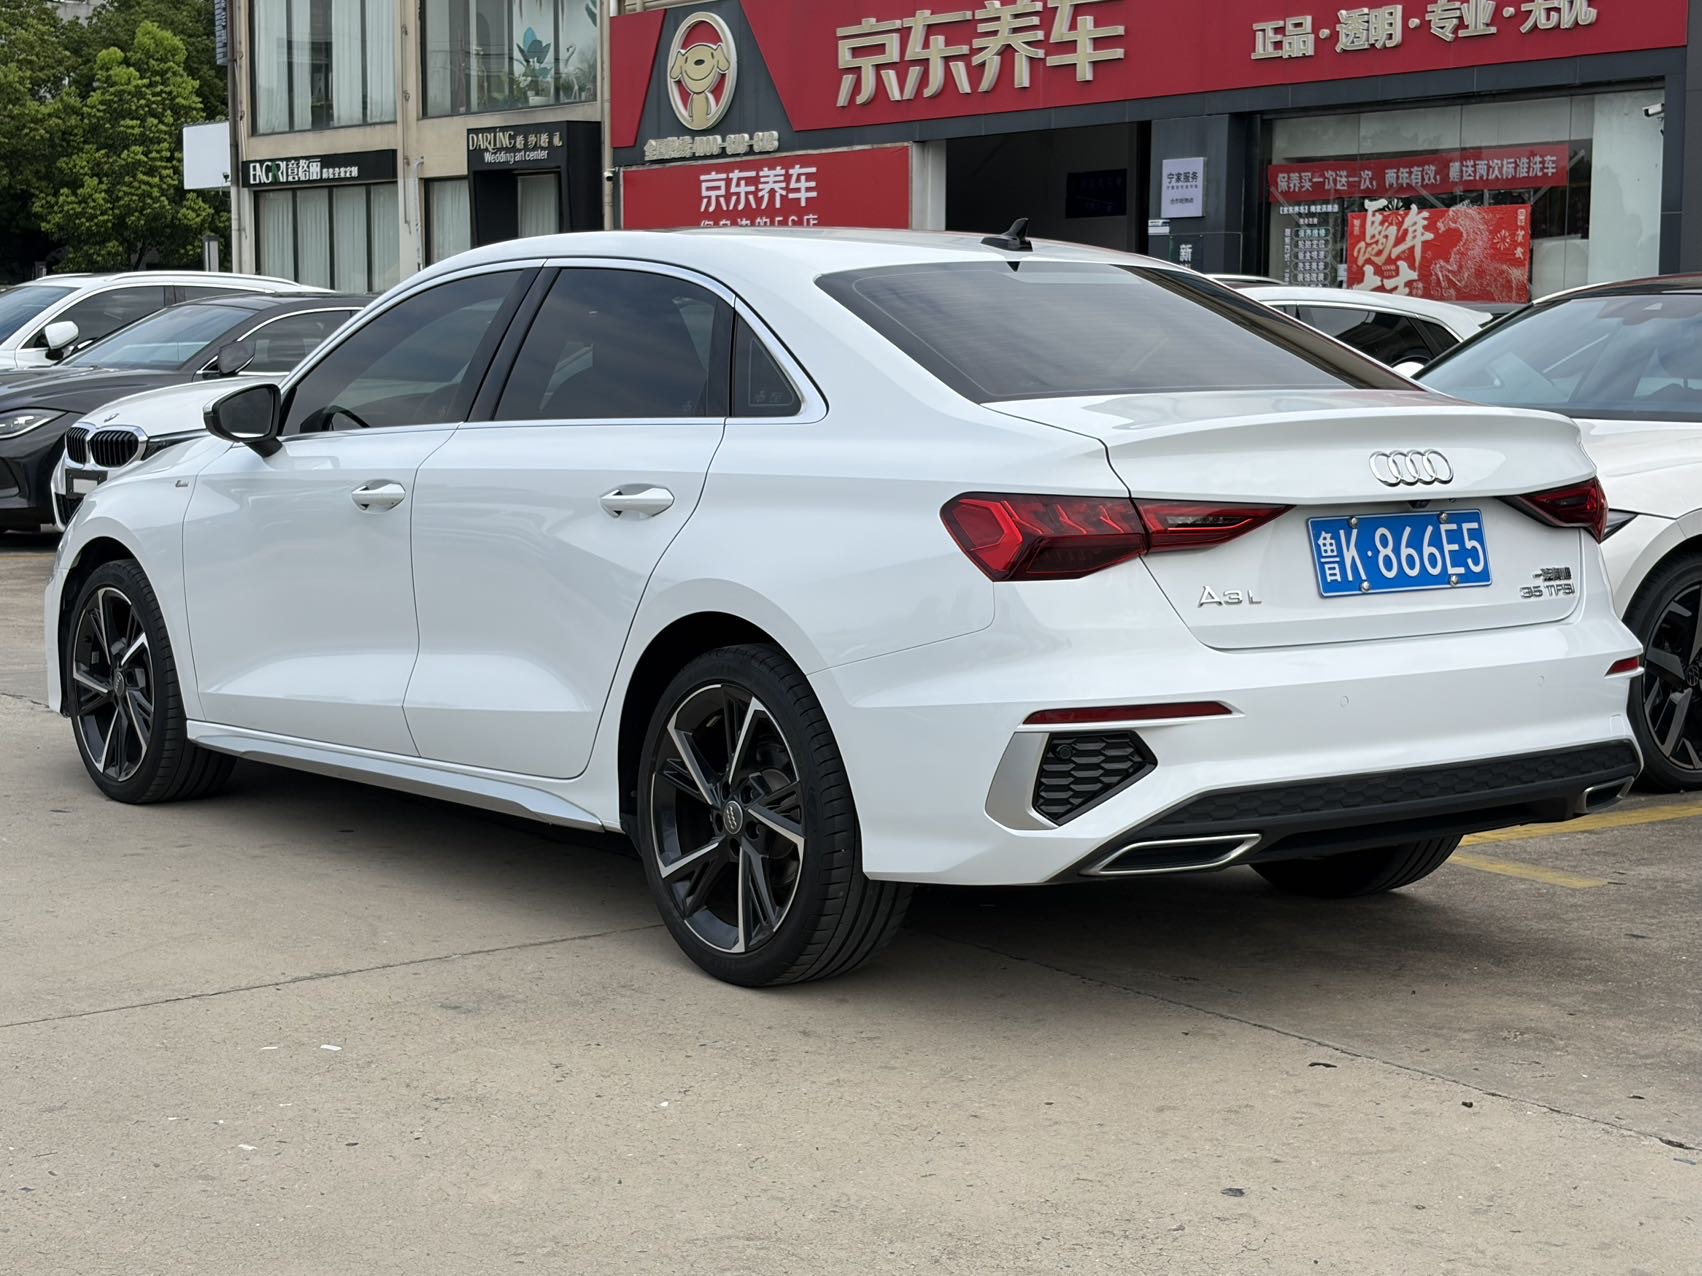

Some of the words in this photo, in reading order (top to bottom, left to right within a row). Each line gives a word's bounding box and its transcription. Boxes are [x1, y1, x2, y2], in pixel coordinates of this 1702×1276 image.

[835, 0, 1125, 107] 京东养车
[469, 129, 515, 152] DARLING
[484, 151, 515, 164] Wedding
[525, 149, 548, 160] center
[700, 165, 818, 212] 京东养车
[1317, 522, 1486, 583] 鲁K·866E5
[1519, 586, 1543, 599] 35
